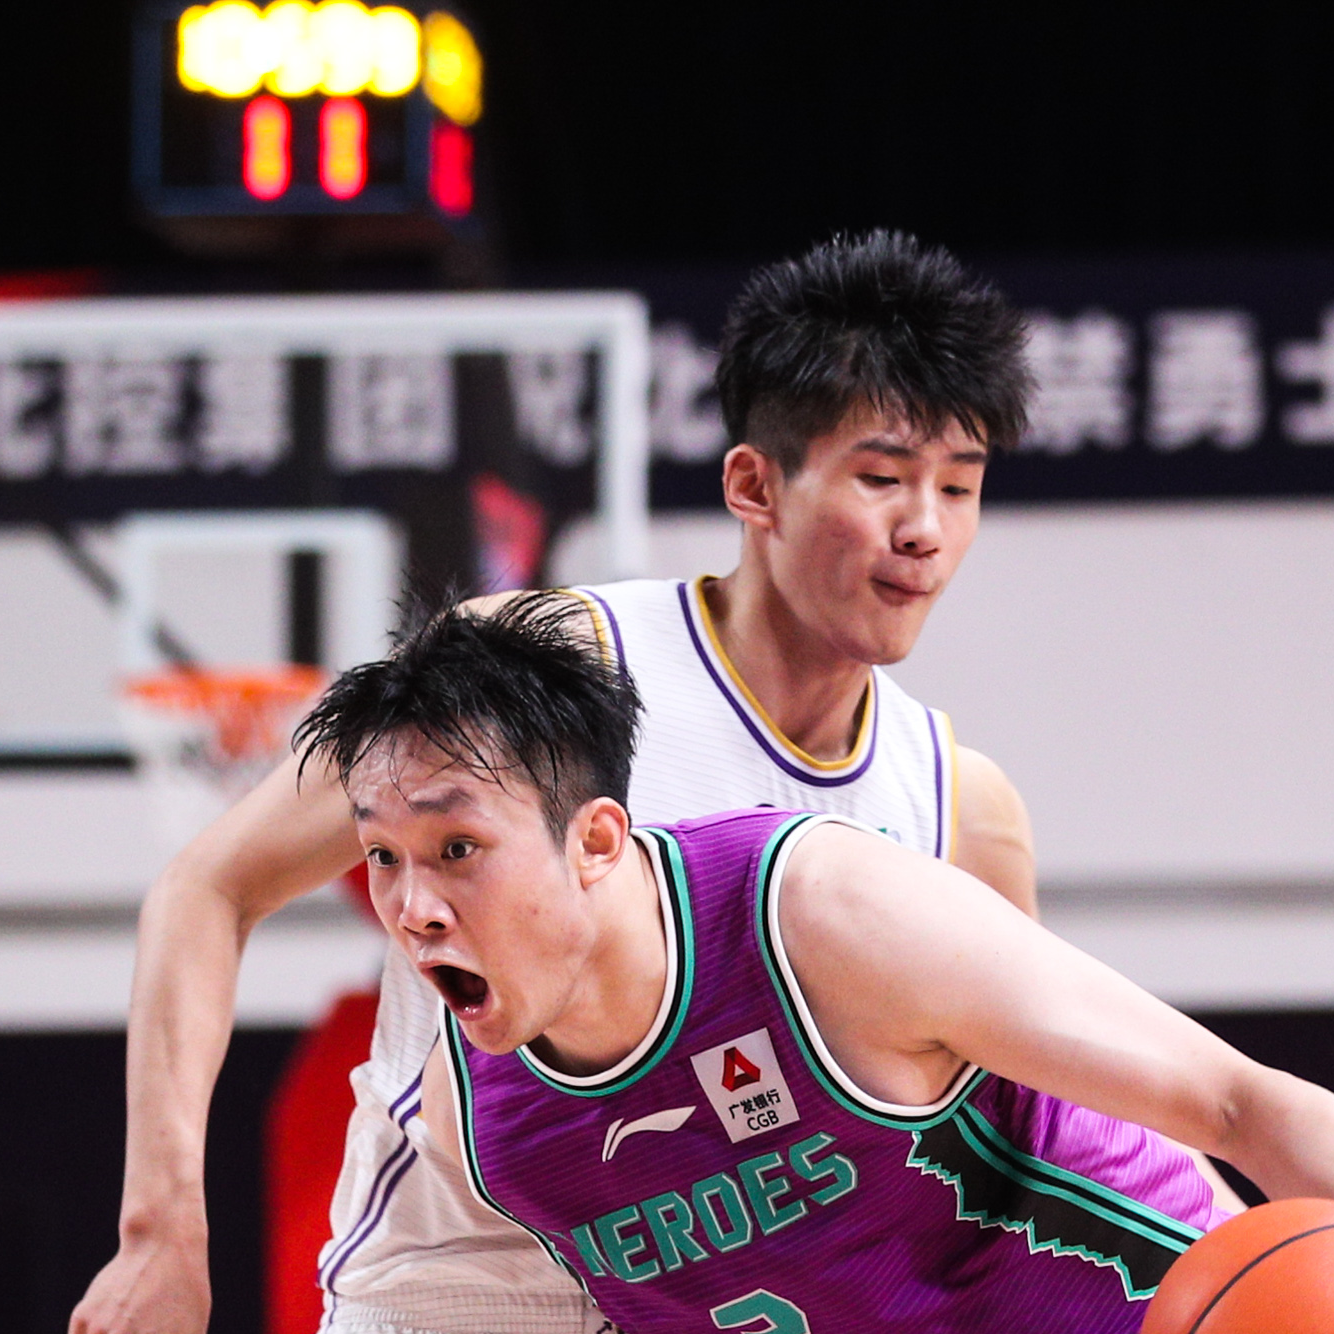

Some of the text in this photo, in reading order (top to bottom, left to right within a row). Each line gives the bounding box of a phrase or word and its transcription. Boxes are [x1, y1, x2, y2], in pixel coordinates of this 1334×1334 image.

[728, 1088, 782, 1119] 广发银行
[747, 1110, 780, 1131] CGB
